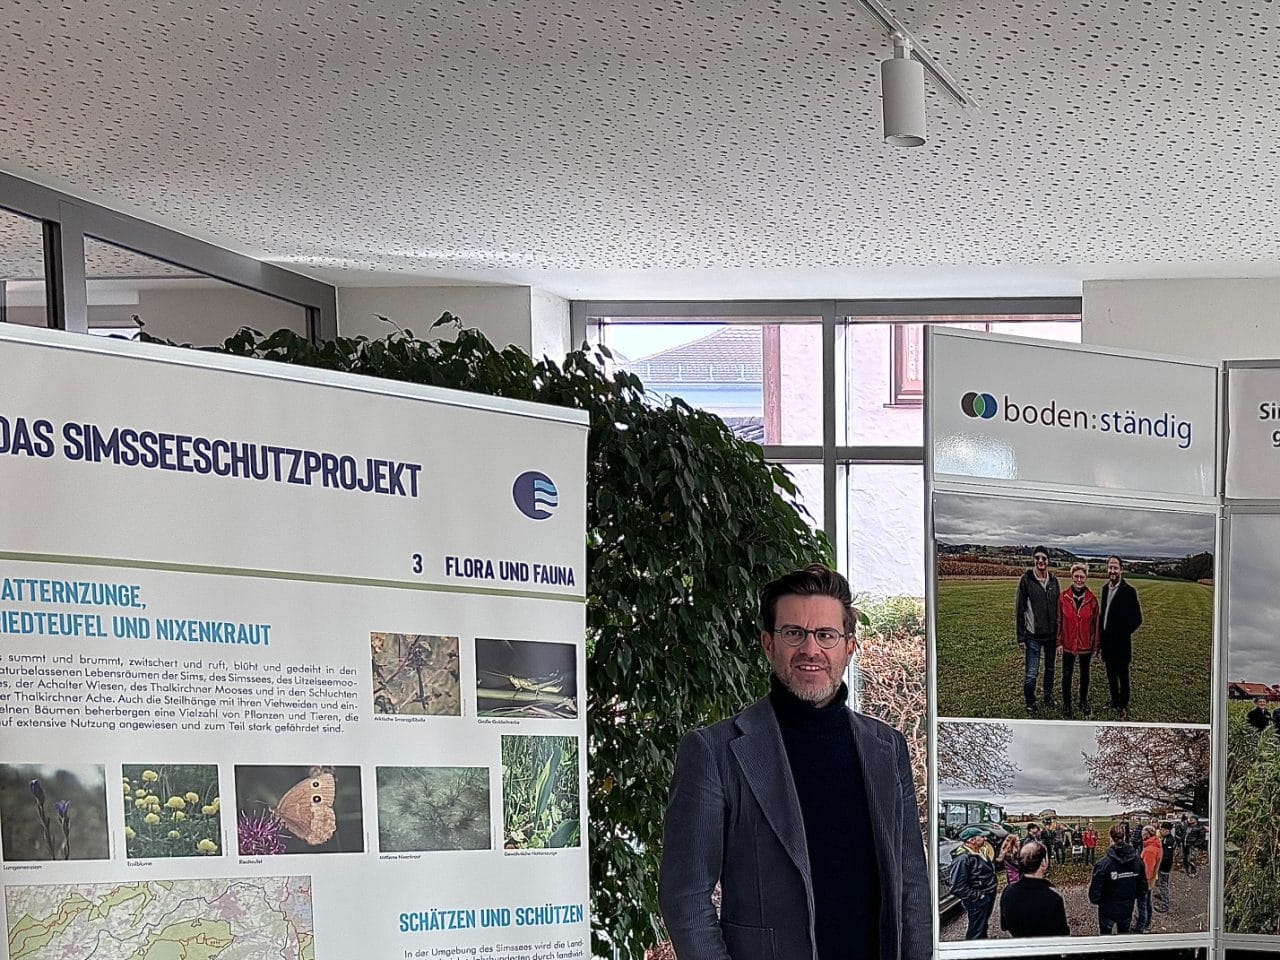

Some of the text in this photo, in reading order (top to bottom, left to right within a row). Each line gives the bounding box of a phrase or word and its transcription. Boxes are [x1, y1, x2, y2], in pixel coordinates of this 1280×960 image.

[1004, 396, 1192, 448] boden:ständig
[62, 422, 421, 497] SIMSSEESCHUTZPROJEKT
[412, 554, 423, 575] 3
[445, 556, 576, 586] FLORA UND FAUNA
[1, 578, 147, 609] ATTERNZUNGE,
[0, 611, 271, 645] IEDTEUFEL UND NIXENKRAUT
[8, 653, 356, 674] summt und brummt, zwitschert und ruft, blüht und gedeiht in den
[84, 667, 159, 679] Lebensräumen
[161, 669, 178, 680] der
[180, 670, 206, 682] Sims,
[208, 671, 226, 681] des
[228, 672, 274, 684] Simssees,
[276, 673, 292, 684] des
[294, 674, 357, 686] Litzelseemoo-
[400, 904, 583, 932] SCHÄTZEN UND SCHÜTZEN
